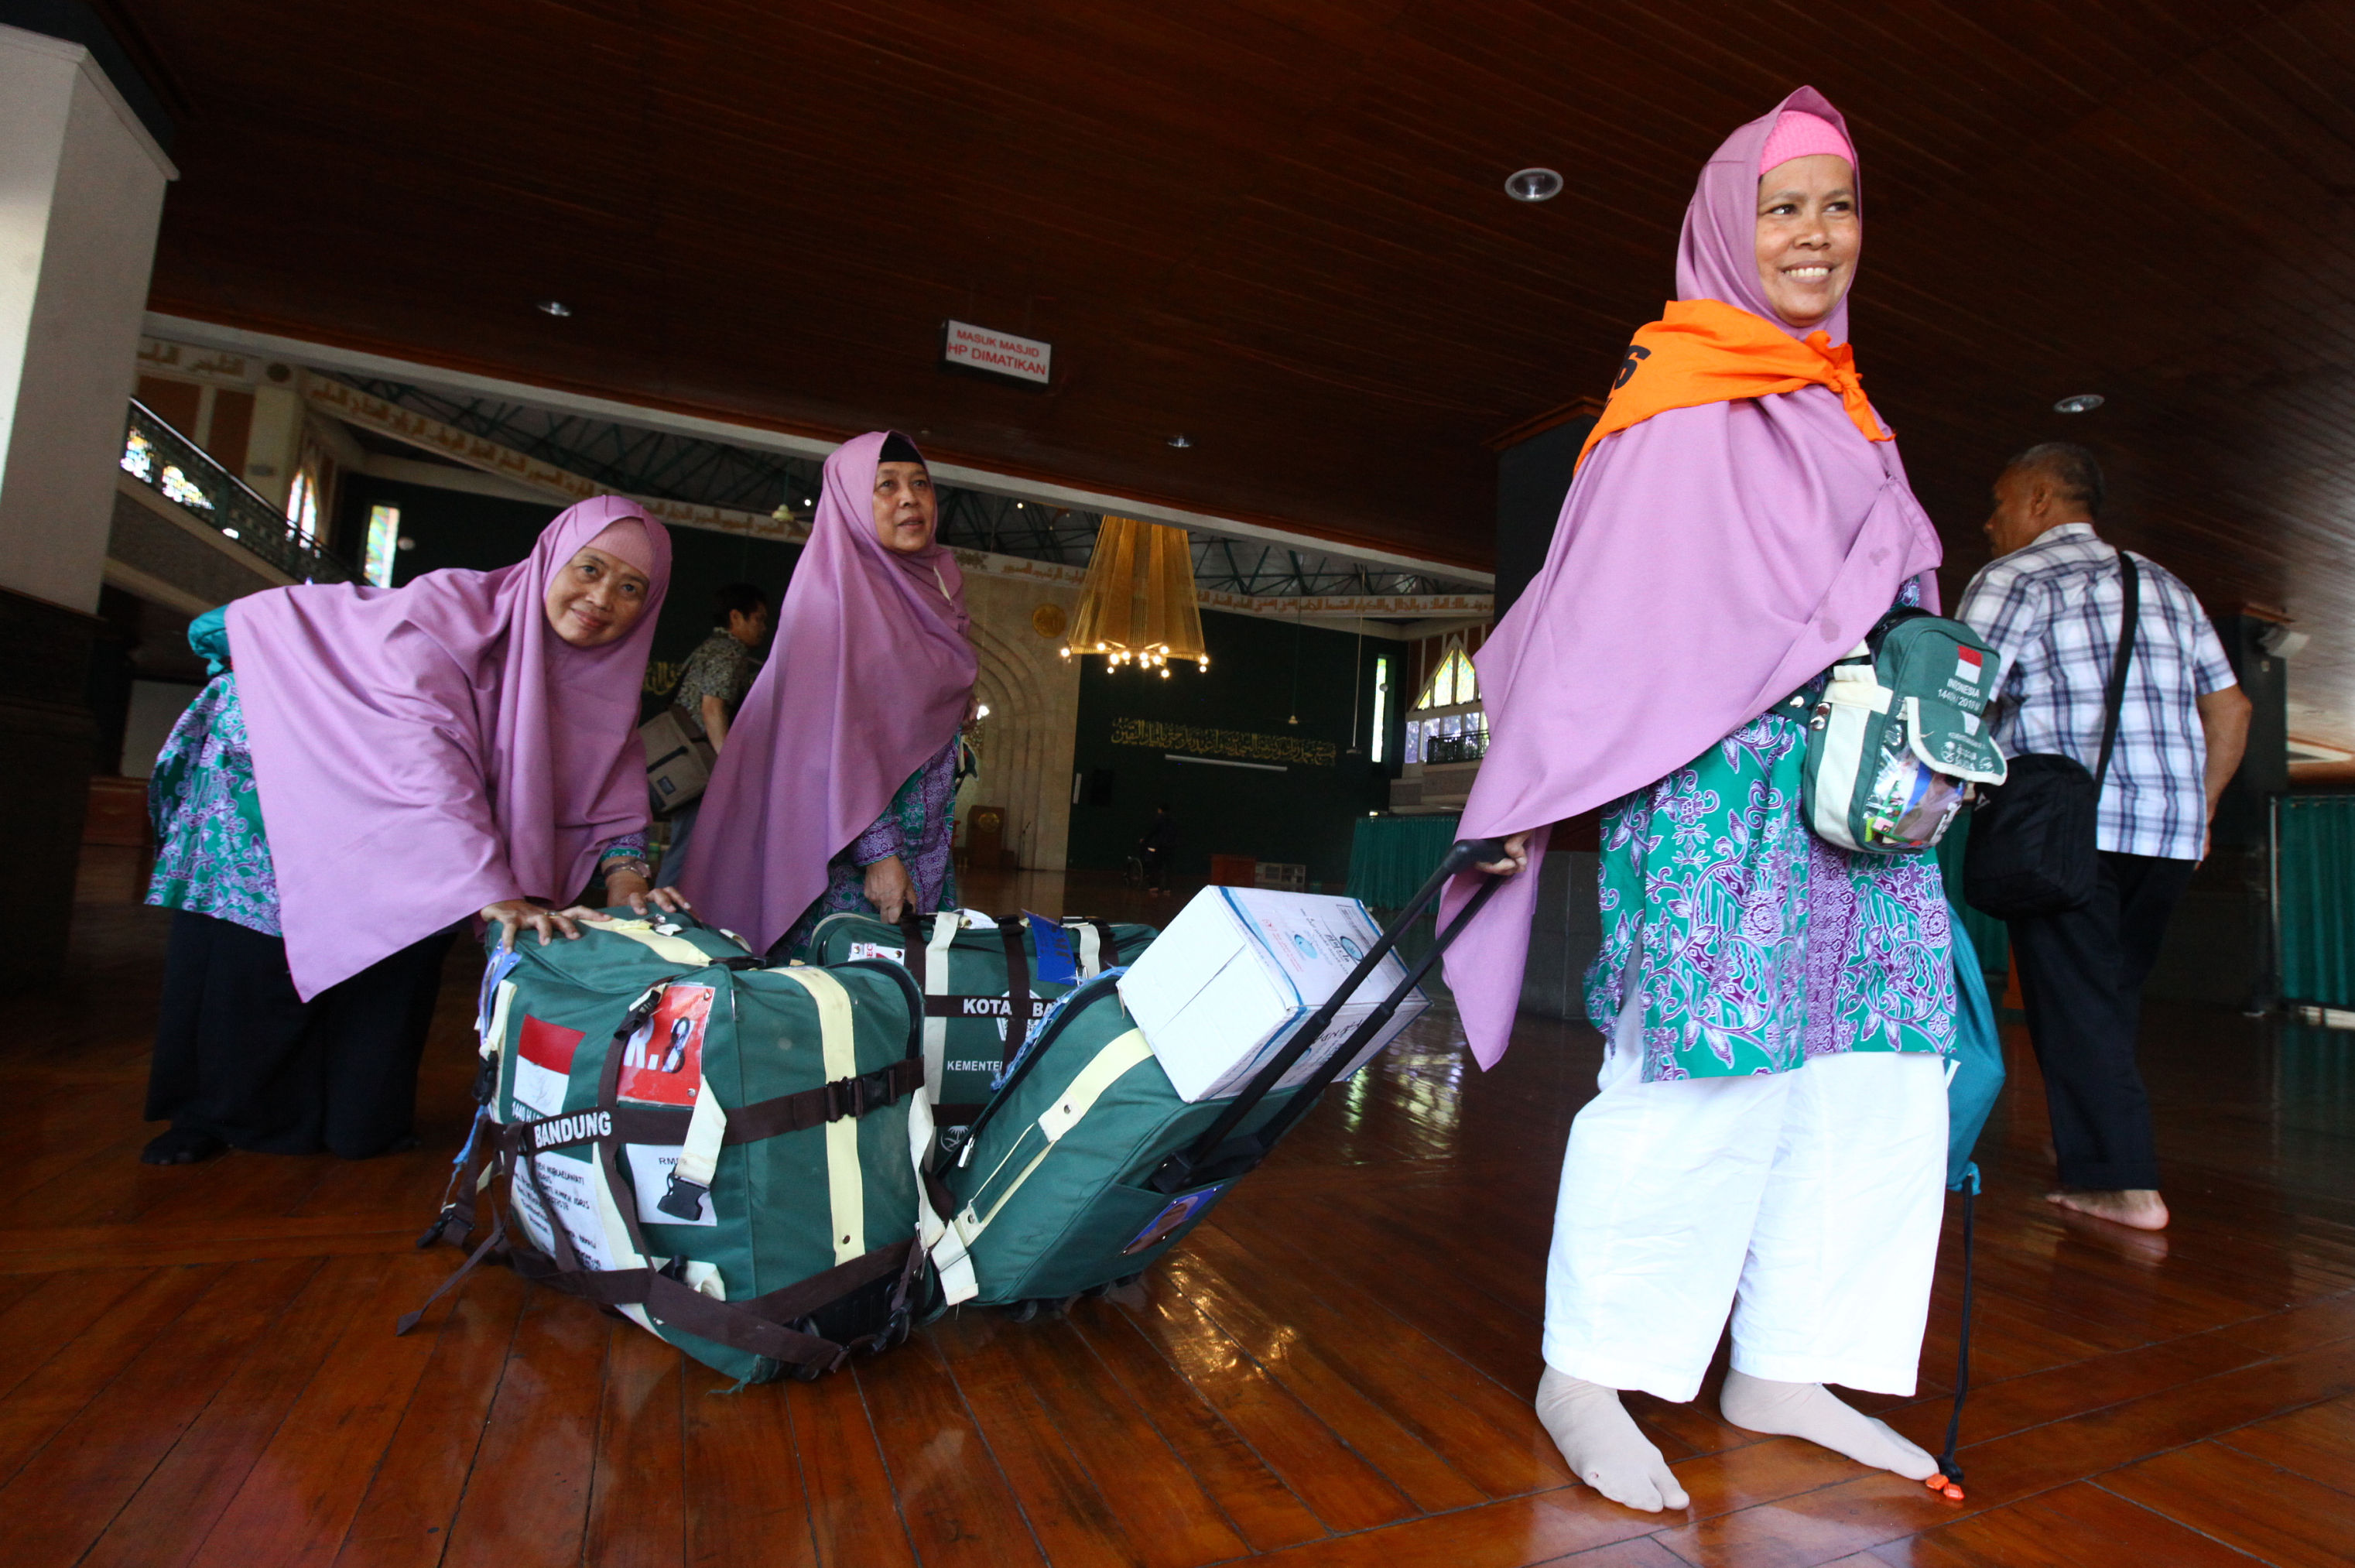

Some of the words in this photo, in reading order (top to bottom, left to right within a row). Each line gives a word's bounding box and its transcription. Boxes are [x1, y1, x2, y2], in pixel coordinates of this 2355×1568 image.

[957, 330, 997, 347] MASUK
[1000, 341, 1039, 358] MASJID
[948, 343, 968, 356] HP
[971, 348, 1046, 375] DIMATIKAN
[1946, 678, 1980, 698] INDONESIA
[963, 998, 1012, 1015] KOTA
[534, 1111, 612, 1149] BANDUNG
